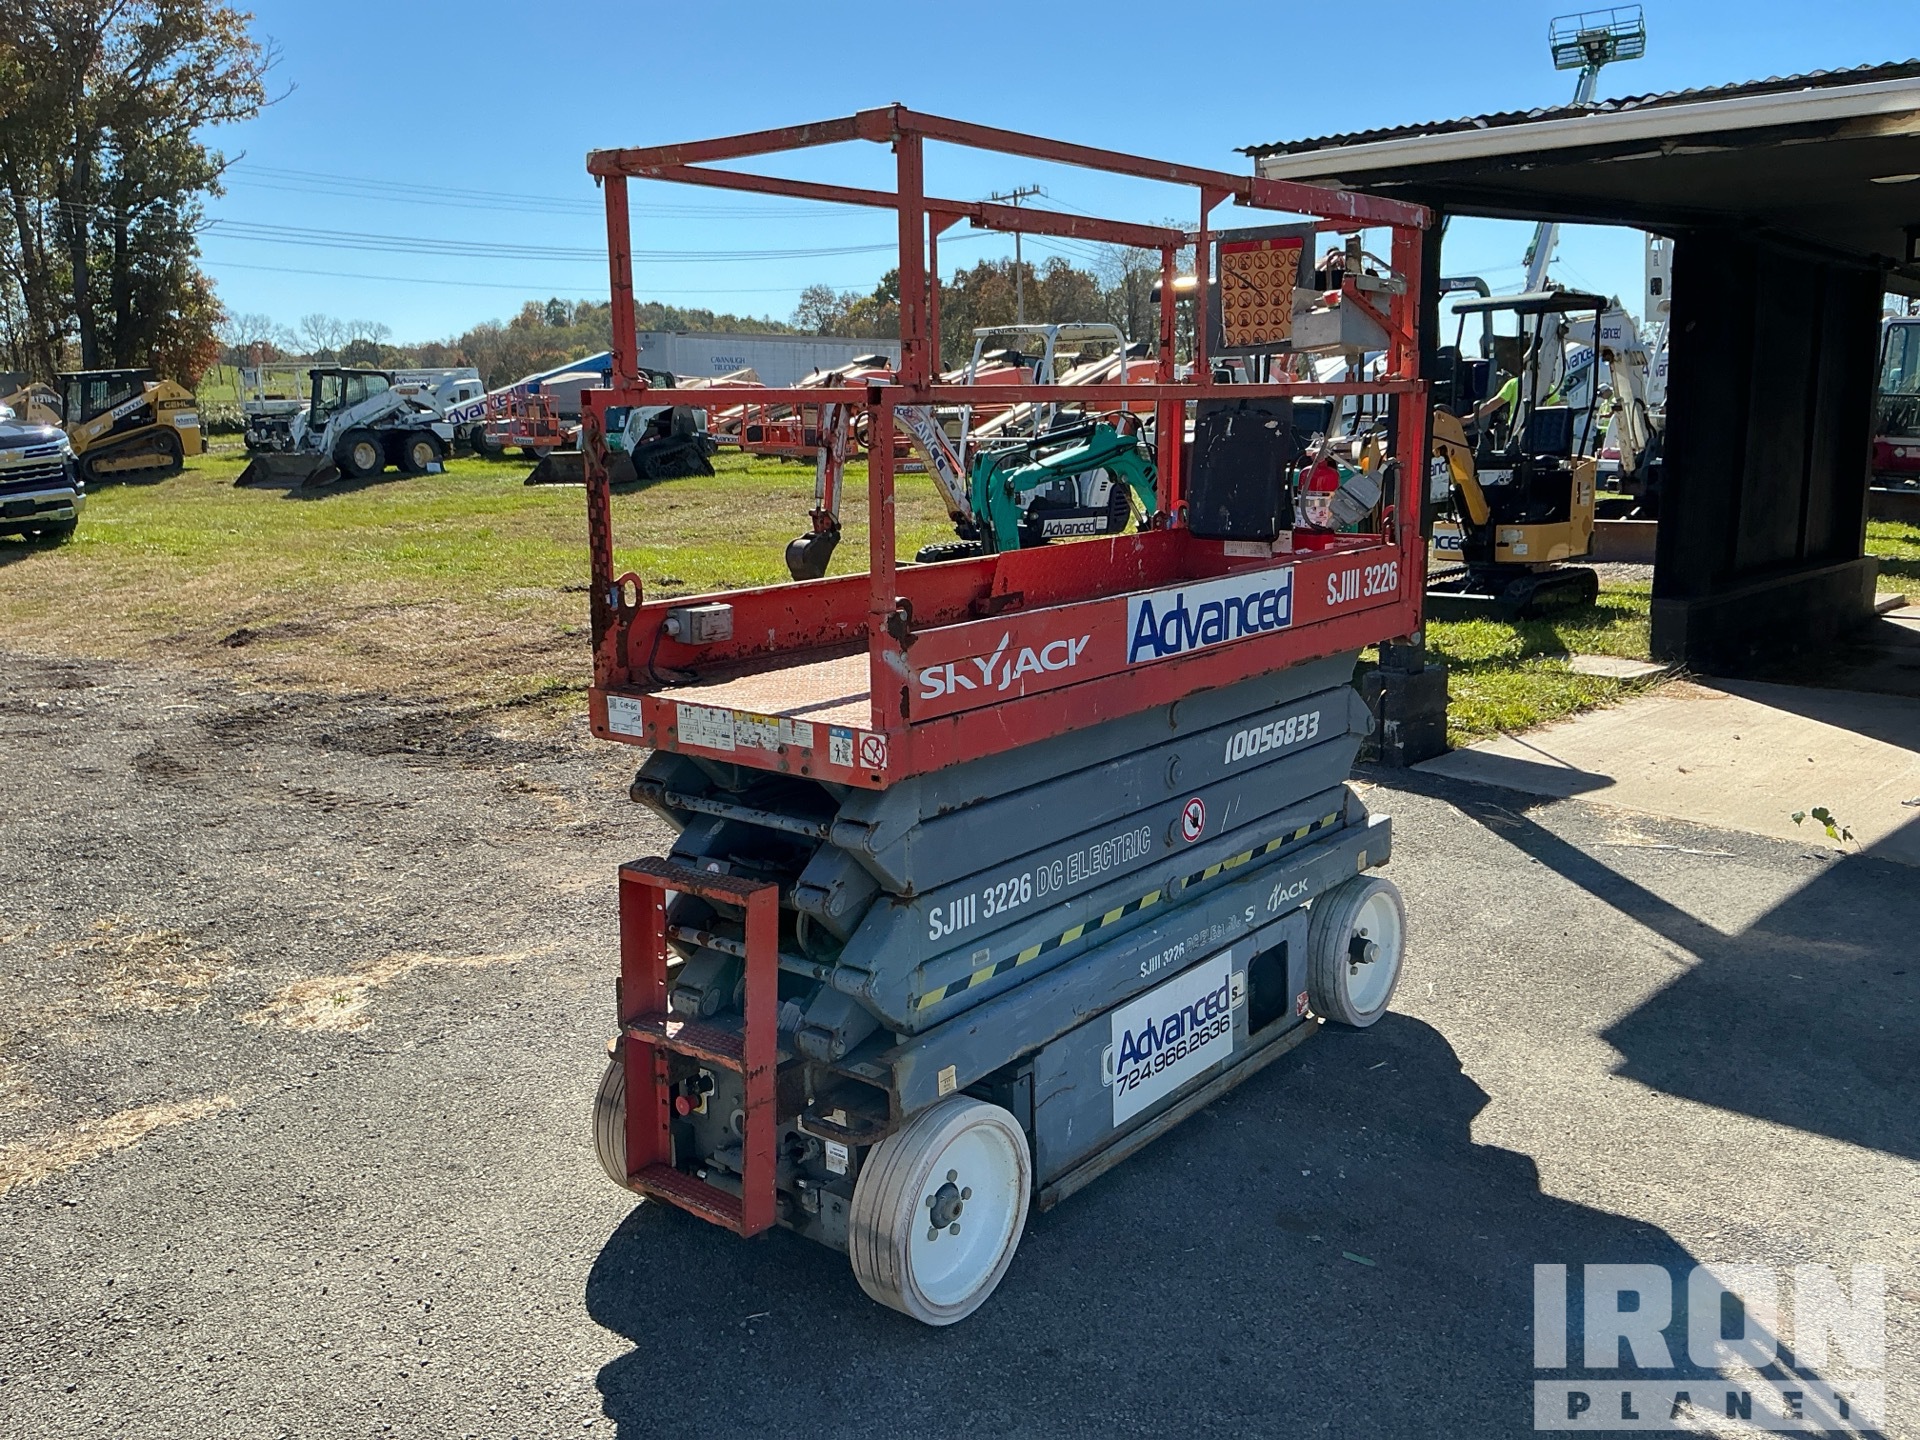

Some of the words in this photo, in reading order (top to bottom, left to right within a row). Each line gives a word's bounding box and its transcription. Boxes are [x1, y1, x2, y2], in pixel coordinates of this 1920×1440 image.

[710, 356, 746, 364] CAVANAUGH
[164, 401, 190, 409] GEHL
[1043, 519, 1096, 536] Advanced
[1363, 561, 1398, 598] 3226
[1128, 571, 1293, 663] Advanced
[920, 631, 1091, 700] SKYJACK
[1224, 711, 1320, 764] 10056833
[982, 872, 1032, 921] 3226
[1036, 861, 1064, 897] DC
[1066, 825, 1152, 884] ELECTRIC
[1116, 974, 1231, 1076] Advanced
[1116, 1014, 1231, 1098] 724.966.2636
